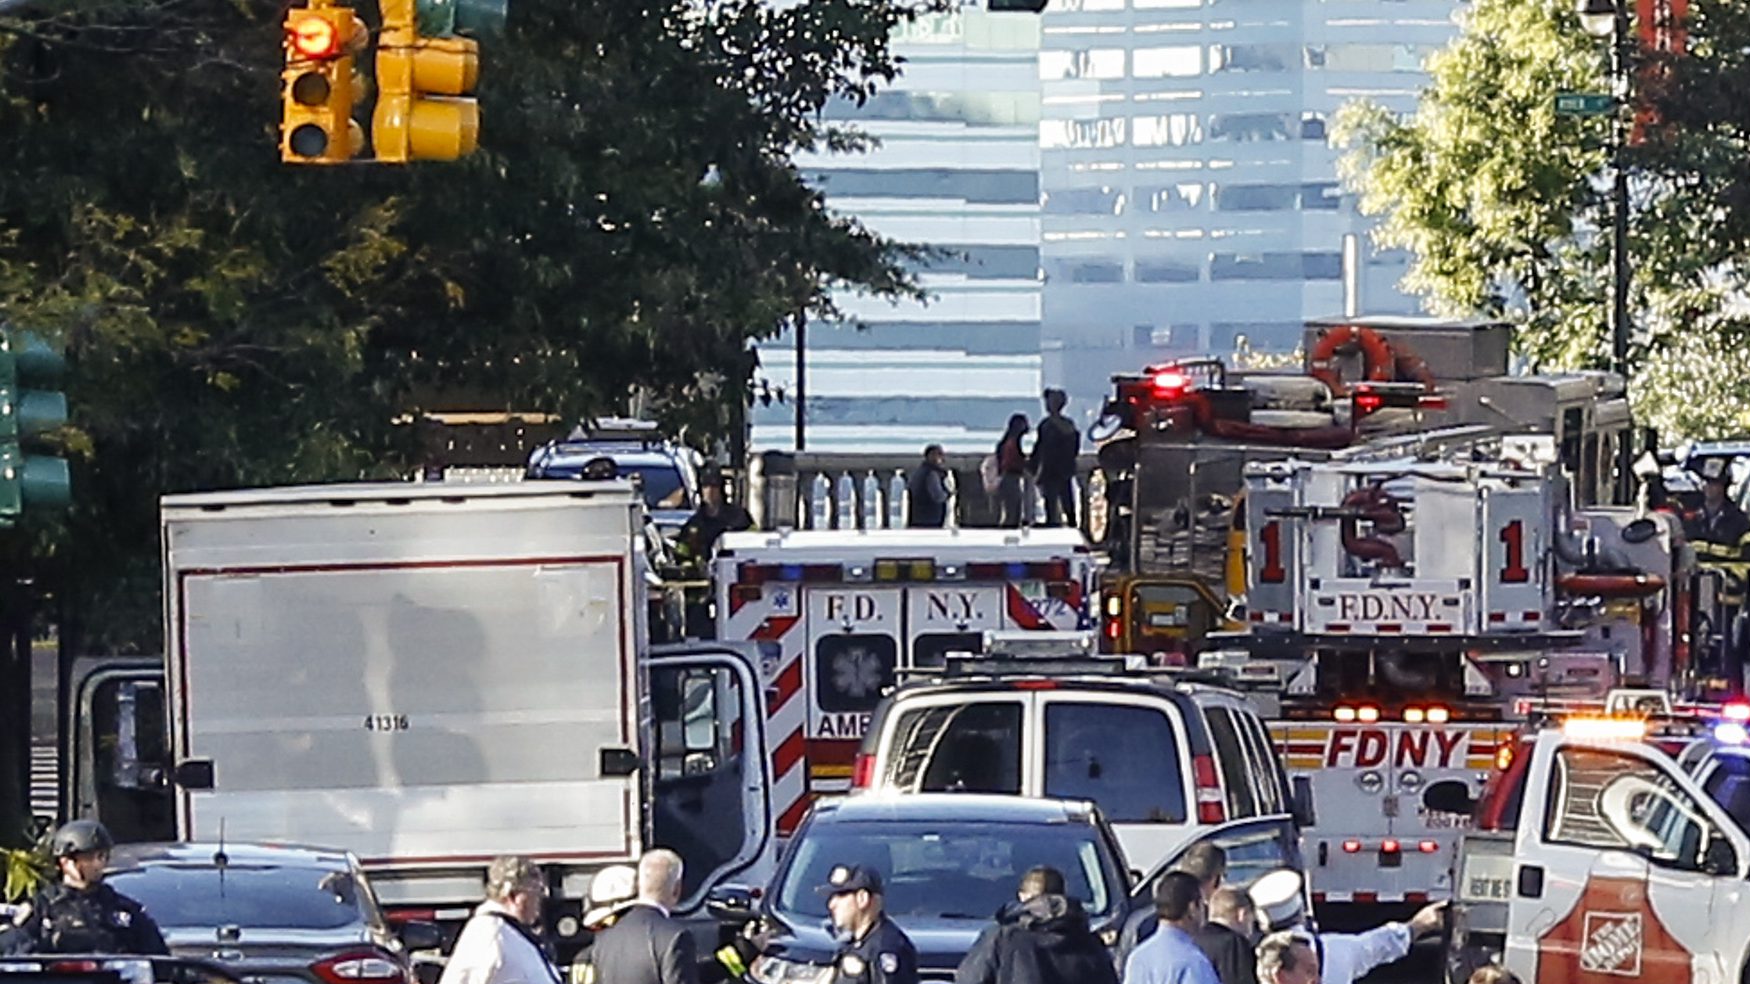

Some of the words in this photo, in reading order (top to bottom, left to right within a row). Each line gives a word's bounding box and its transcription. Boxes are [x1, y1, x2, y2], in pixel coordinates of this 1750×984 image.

[1260, 520, 1285, 584] 1
[1500, 520, 1529, 584] 1
[826, 595, 884, 621] F.D.
[927, 593, 984, 620] N.Y.
[1339, 594, 1441, 621] F.D.N.Y.
[364, 713, 409, 731] 41316
[1327, 729, 1468, 768] FDNY
